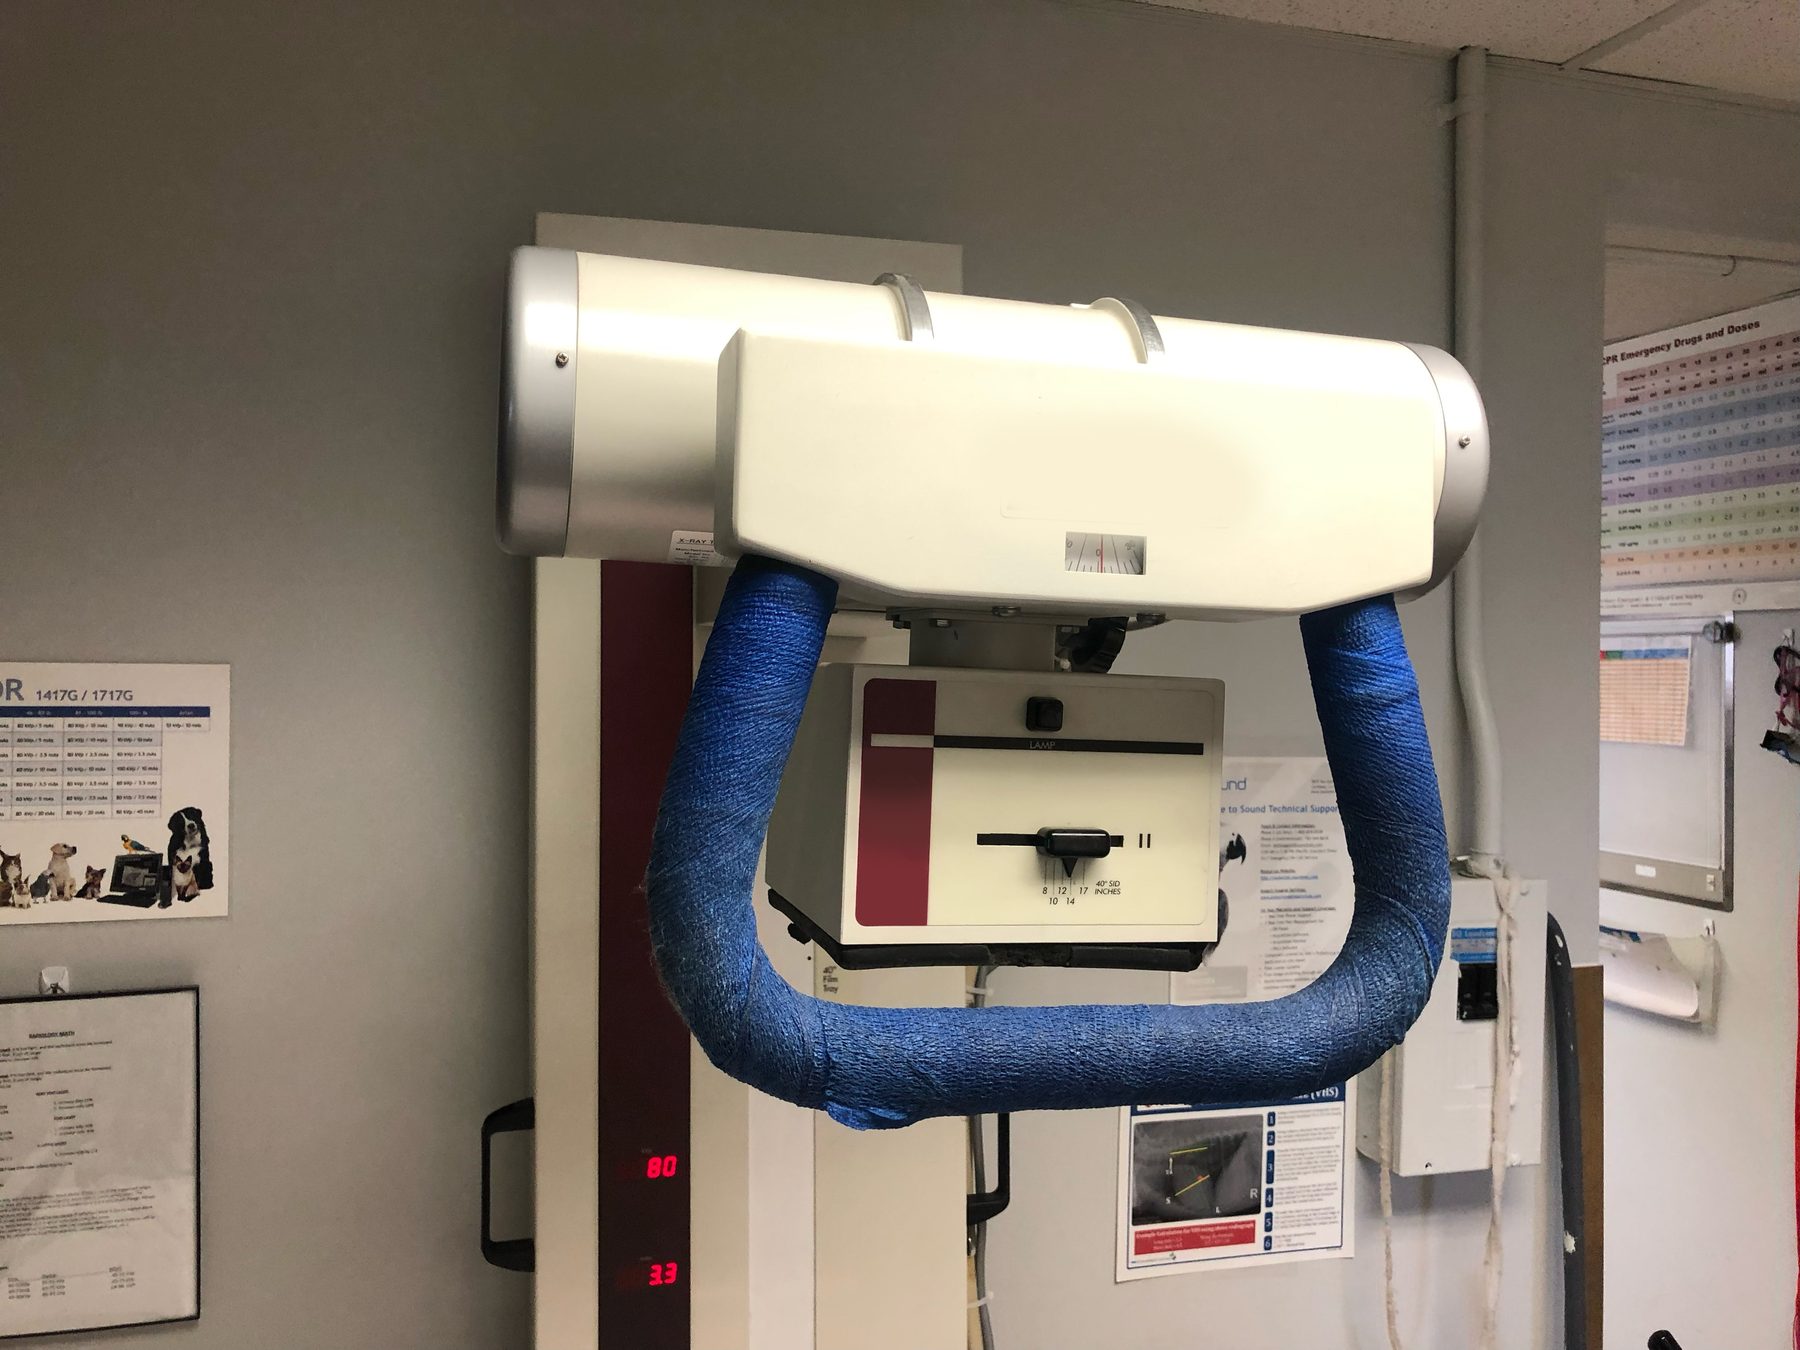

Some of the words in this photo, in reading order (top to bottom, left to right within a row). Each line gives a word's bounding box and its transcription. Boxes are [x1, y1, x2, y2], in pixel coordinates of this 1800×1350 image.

[1620, 343, 1671, 361] Emergency
[1674, 335, 1703, 348] Drugs
[1705, 328, 1724, 340] and
[1727, 320, 1760, 335] Doses
[0, 678, 24, 701] R
[36, 690, 78, 701] 1417G
[92, 690, 133, 701] 1717G
[1030, 740, 1055, 749] LAMP
[1221, 778, 1247, 790] und
[1240, 804, 1266, 813] Sound
[1269, 804, 1308, 813] Technical
[1311, 805, 1338, 814] Suppor
[1042, 887, 1048, 895] 8
[1058, 887, 1067, 895] 12
[1079, 887, 1088, 895] 17
[1049, 897, 1058, 905] 10
[1066, 897, 1075, 905] 14
[823, 975, 838, 983] Film
[823, 985, 838, 994] Tray
[1311, 1087, 1339, 1100] (VHS)
[647, 1155, 677, 1179] 80
[1250, 1188, 1258, 1199] R
[649, 1262, 677, 1285] 3.3
